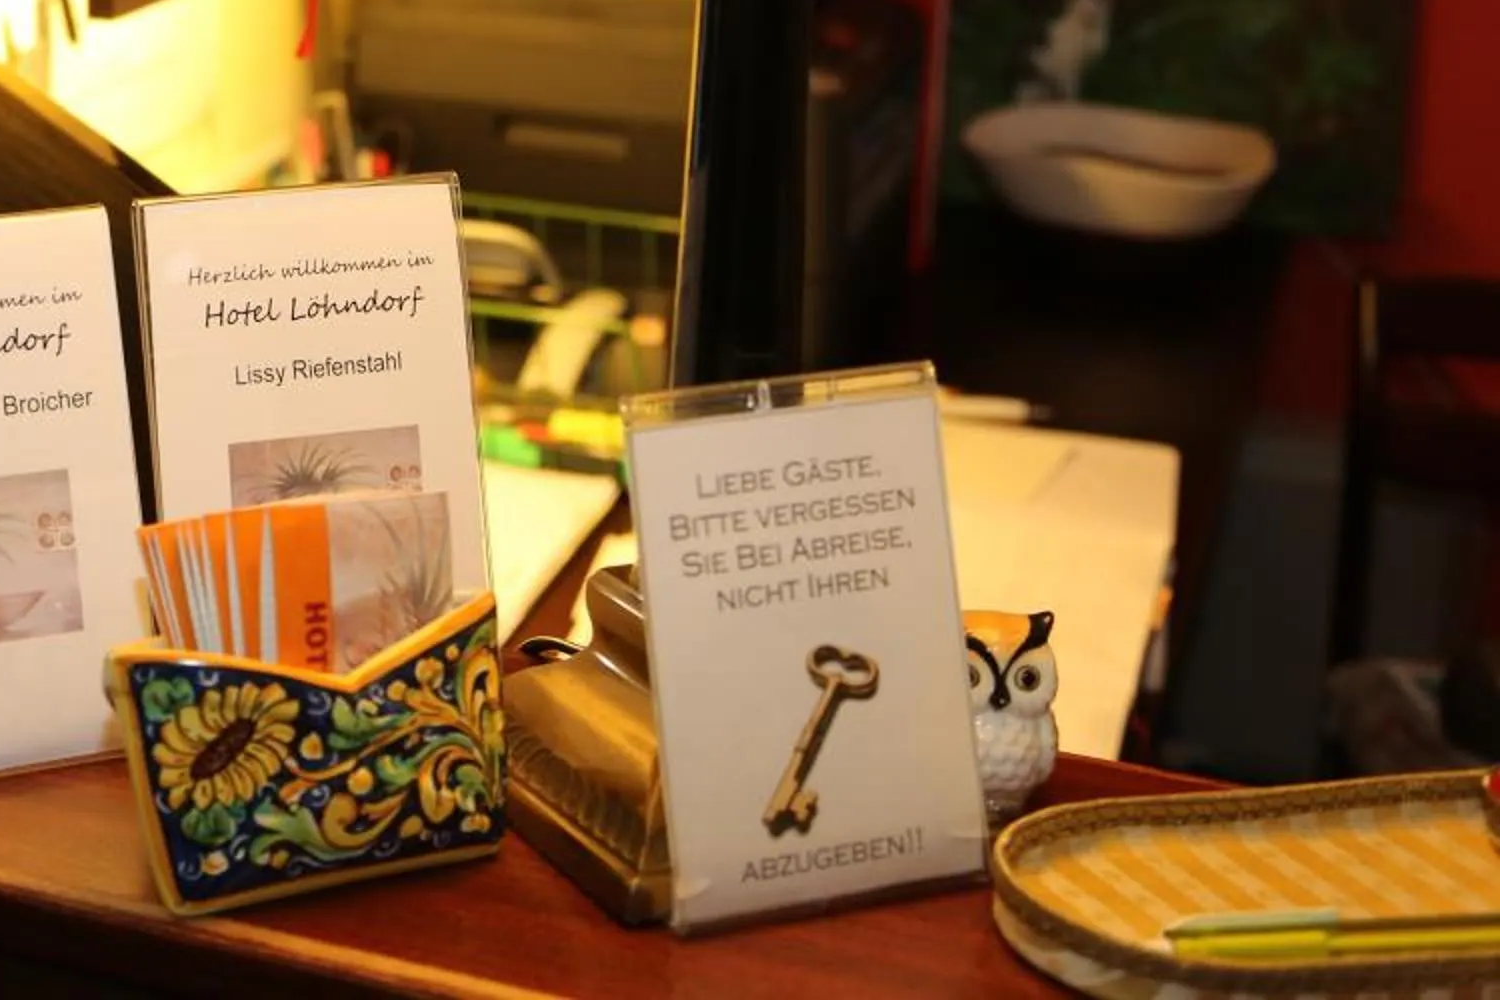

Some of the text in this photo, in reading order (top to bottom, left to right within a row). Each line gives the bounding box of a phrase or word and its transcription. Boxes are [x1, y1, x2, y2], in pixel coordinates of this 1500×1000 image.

[188, 250, 435, 287] Herzlich willkommen im
[50, 287, 83, 304] im
[205, 285, 425, 328] Hotel Löhndorf
[235, 351, 403, 387] Lissy Riefenstahl
[2, 390, 94, 417] Broicher
[696, 468, 776, 500] LIEBE
[669, 487, 916, 542] BITTE VERGESSEN
[681, 551, 731, 578] SIE
[736, 543, 783, 571] BEI
[716, 566, 891, 612] NICHT IHREN
